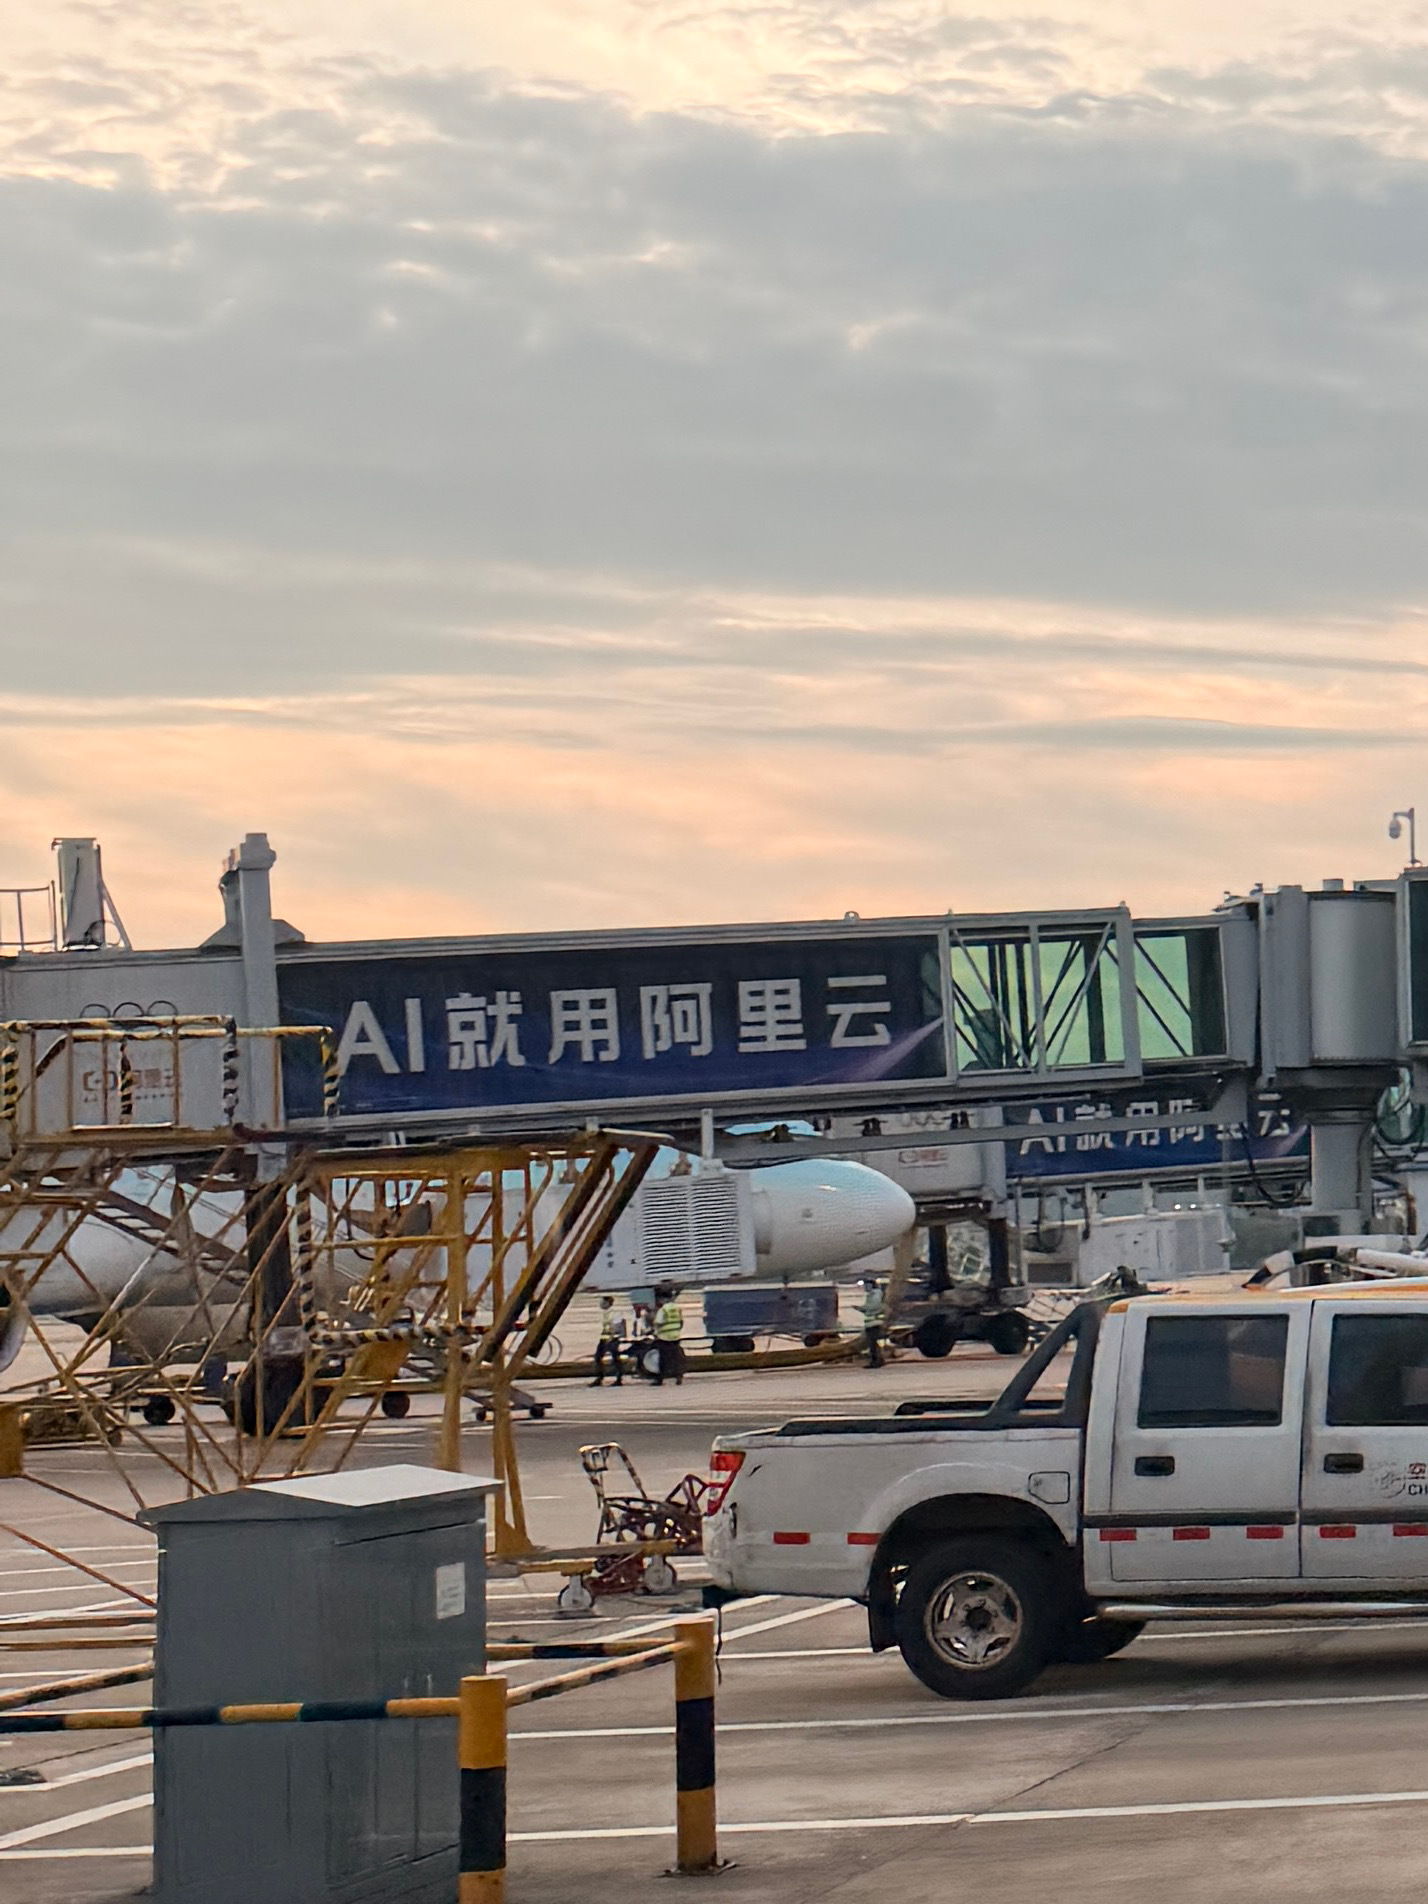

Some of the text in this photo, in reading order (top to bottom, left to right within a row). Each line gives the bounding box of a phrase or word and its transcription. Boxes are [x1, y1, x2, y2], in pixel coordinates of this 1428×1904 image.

[336, 973, 893, 1075] AI就用阿里云
